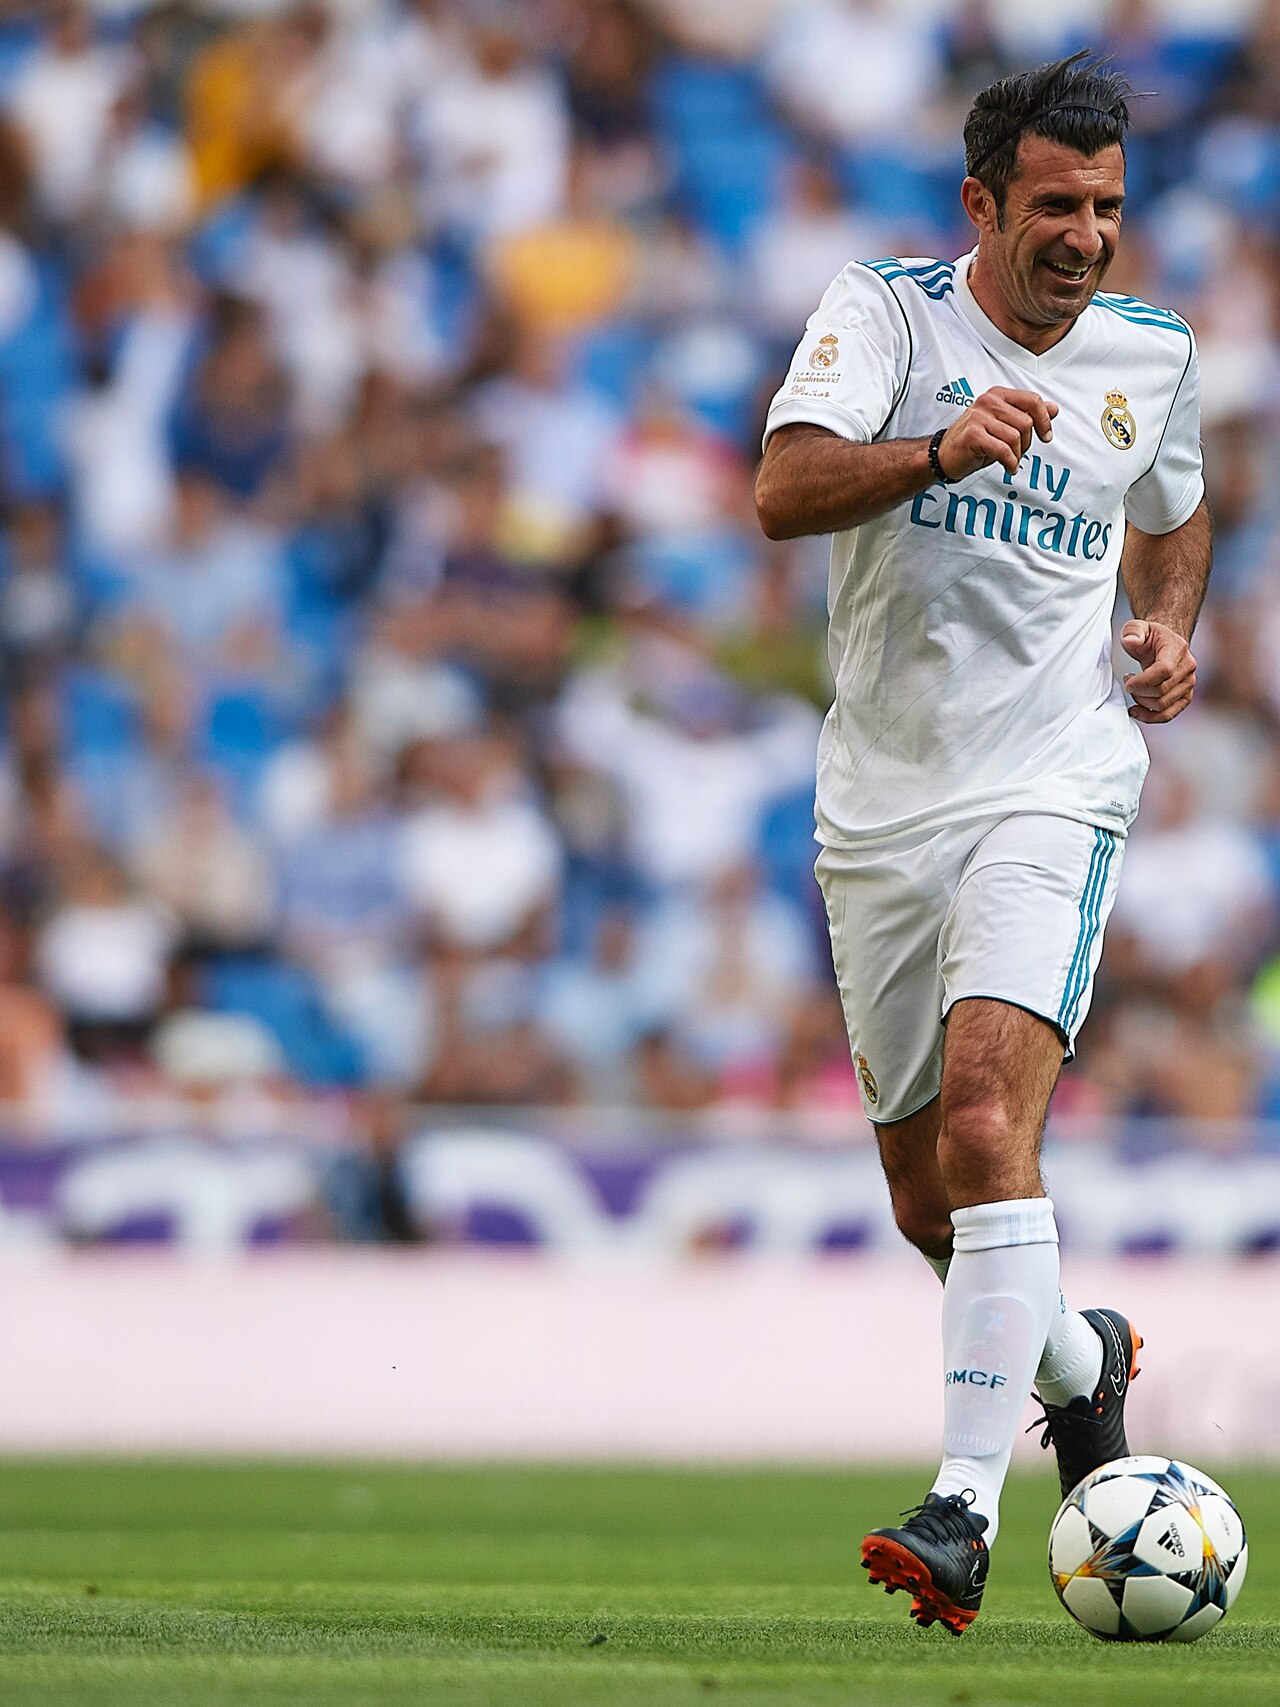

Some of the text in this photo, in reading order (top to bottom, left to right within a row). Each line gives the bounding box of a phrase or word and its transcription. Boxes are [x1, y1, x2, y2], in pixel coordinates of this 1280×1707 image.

[936, 391, 974, 408] adida
[910, 480, 1113, 562] Emirates
[1169, 1522, 1186, 1558] adidas
